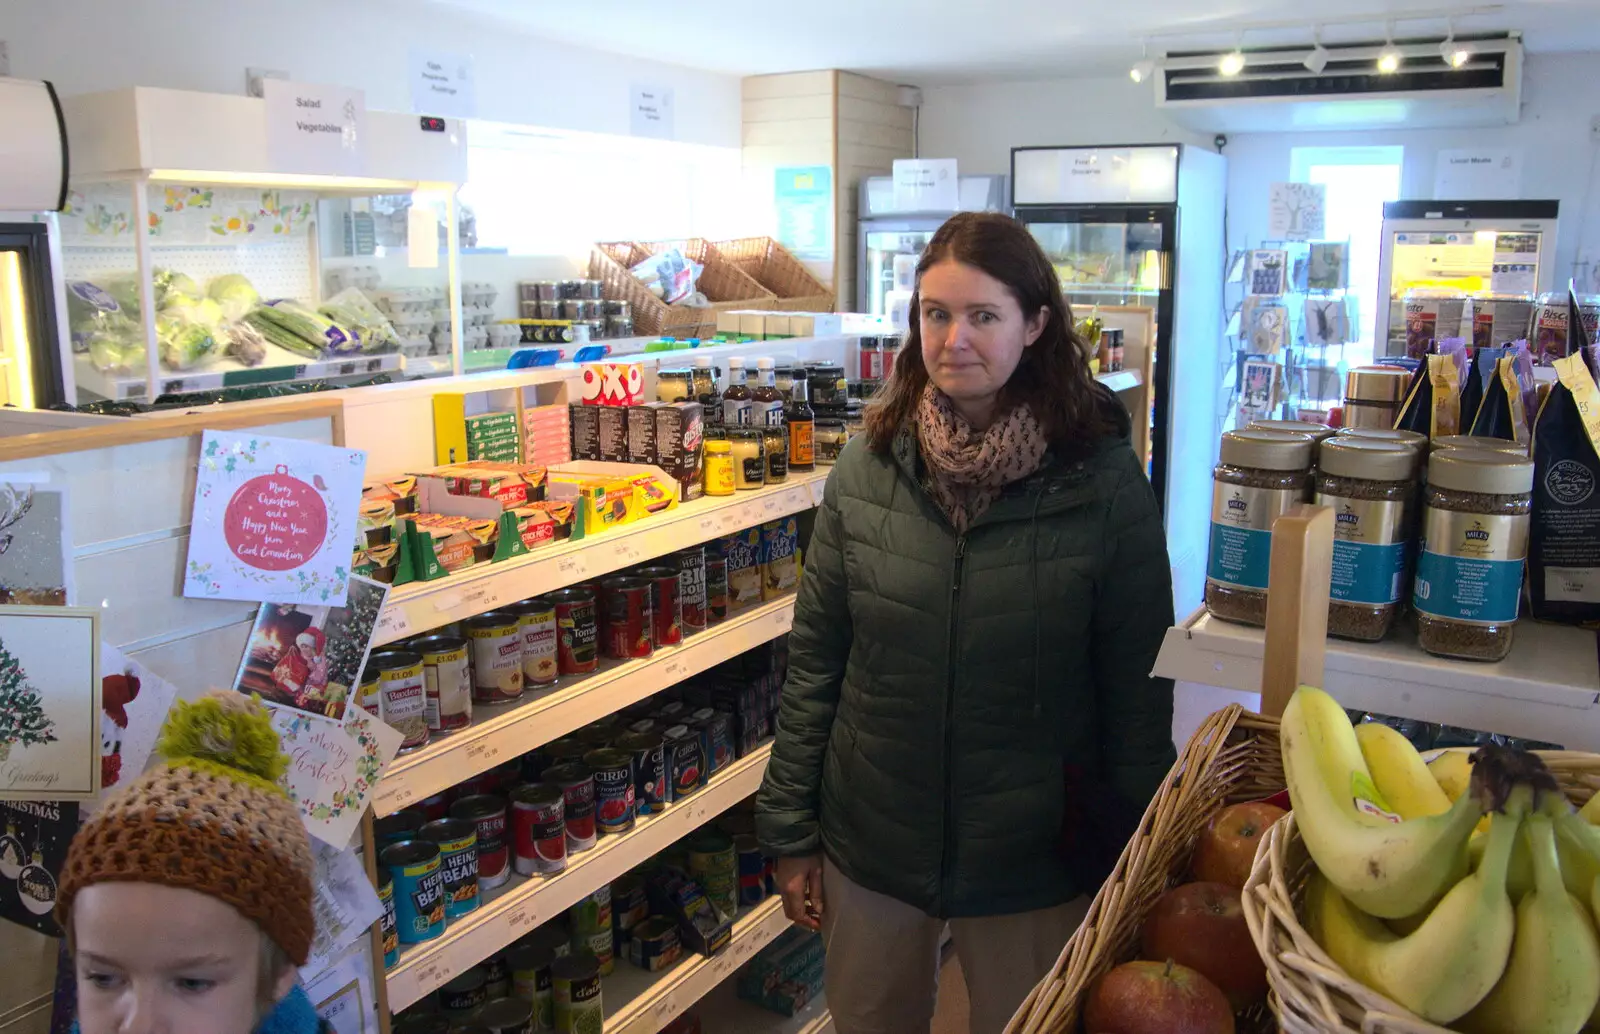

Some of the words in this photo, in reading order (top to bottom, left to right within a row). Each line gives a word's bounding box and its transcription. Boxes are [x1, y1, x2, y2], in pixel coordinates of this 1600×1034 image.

[296, 97, 321, 109] Salad
[296, 121, 342, 134] Vegetables
[582, 364, 643, 400] OXO
[768, 409, 784, 425] HP
[269, 481, 292, 497] Merry
[258, 492, 299, 508] Christmas
[265, 509, 281, 518] and
[241, 516, 267, 535] Happy
[270, 521, 288, 533] New
[290, 522, 309, 536] Year
[264, 535, 283, 544] from
[522, 530, 536, 542] STOCK
[1466, 531, 1488, 540] MILES
[237, 544, 258, 556] Card
[260, 546, 304, 562] Connection
[438, 552, 453, 563] STOCK
[453, 550, 463, 560] POT
[771, 547, 791, 560] SOUP
[728, 556, 753, 571] SOUP
[529, 616, 549, 625] £1.09
[436, 655, 458, 664] £1.09
[391, 670, 413, 680] £1.09
[389, 686, 422, 701] Baxters
[309, 732, 349, 769] Merry
[4, 768, 60, 788] Greetings
[594, 768, 628, 782] CIRIO
[447, 850, 476, 869] HEINZ
[442, 860, 479, 884] BEANZ
